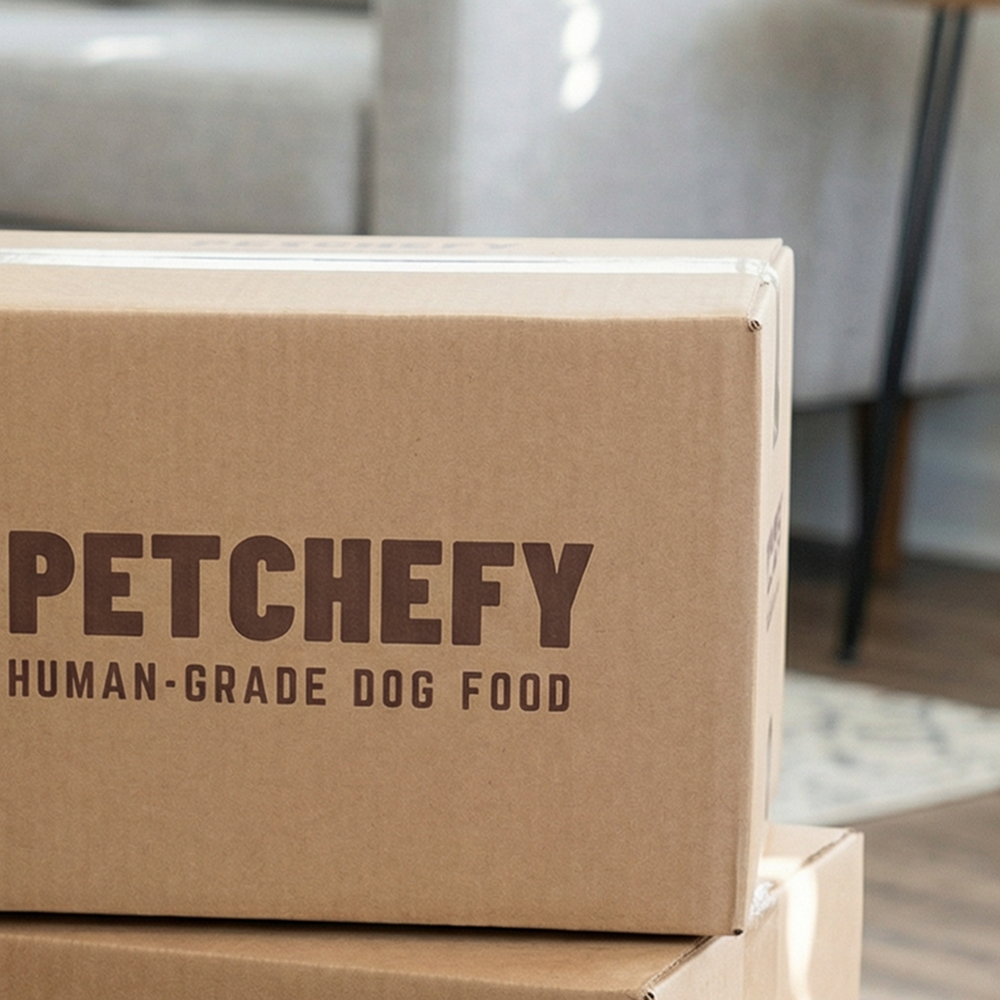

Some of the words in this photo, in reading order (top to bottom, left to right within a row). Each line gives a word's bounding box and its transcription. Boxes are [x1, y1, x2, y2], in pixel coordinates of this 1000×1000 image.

[8, 530, 594, 649] PETCHEFY
[8, 658, 327, 706] HUMAN-GRADE
[353, 668, 434, 709] DOG
[462, 671, 571, 712] FOOD
